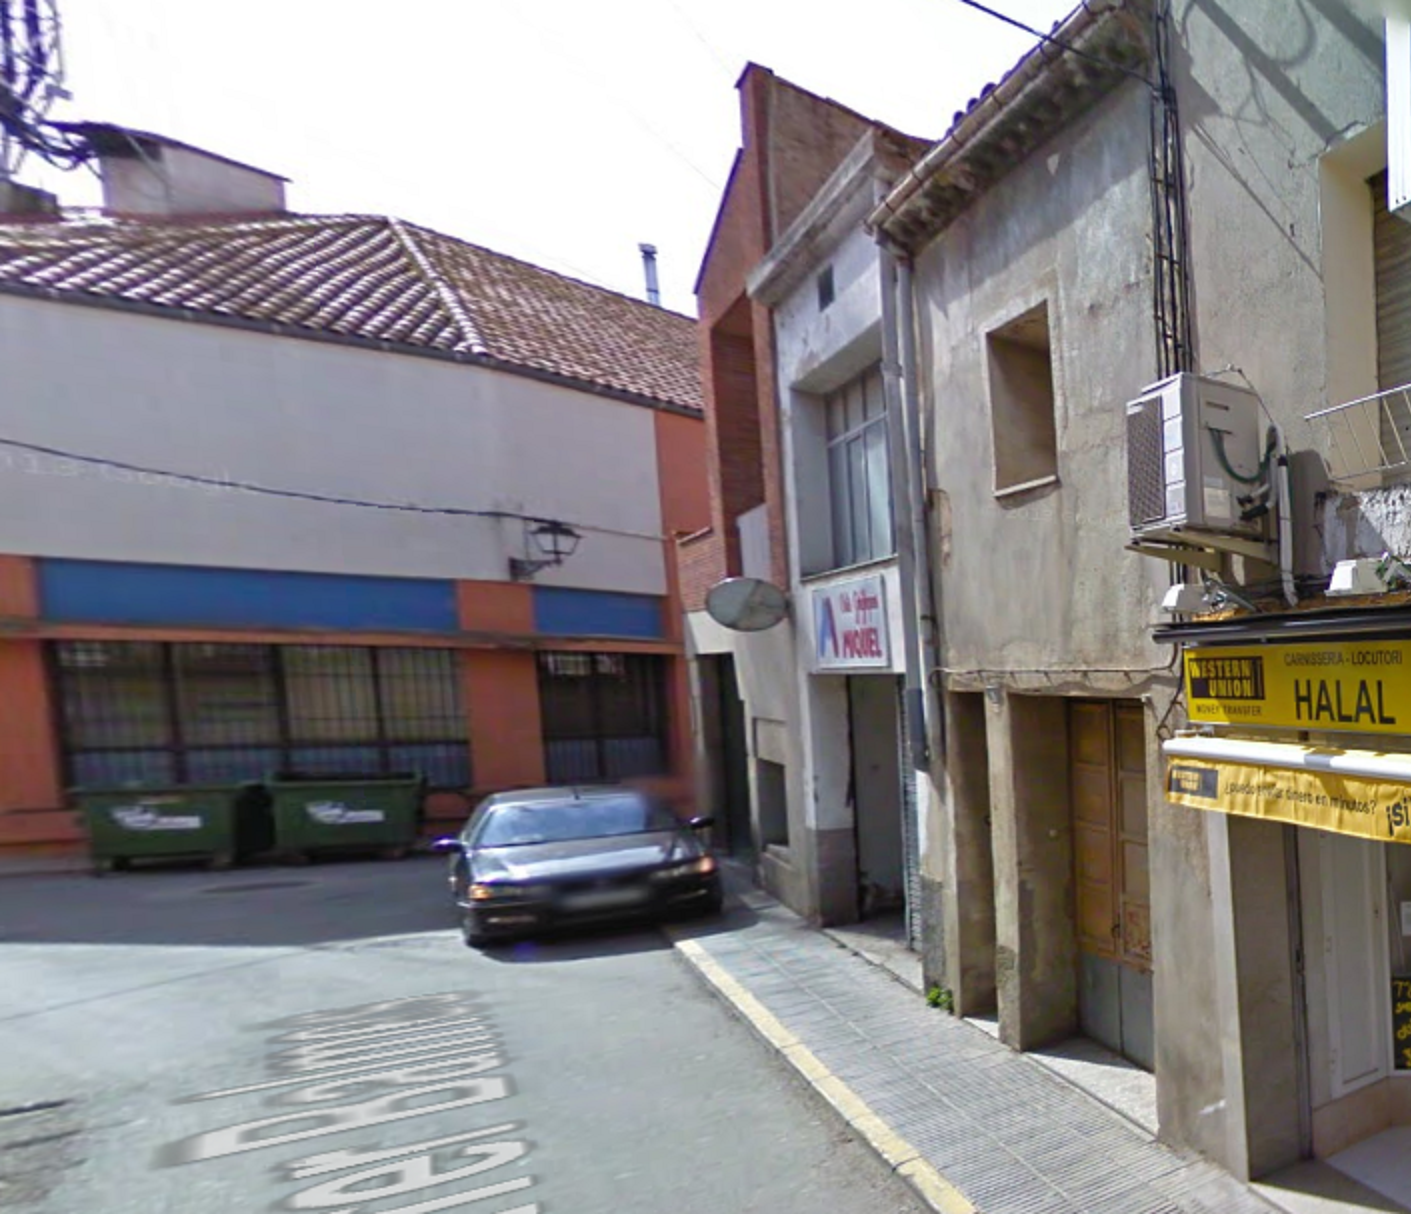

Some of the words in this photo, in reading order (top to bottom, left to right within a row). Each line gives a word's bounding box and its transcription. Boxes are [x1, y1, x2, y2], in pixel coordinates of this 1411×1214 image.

[843, 628, 882, 658] MIQUEL
[1284, 651, 1344, 666] CARNISSERIA
[1351, 650, 1403, 665] LOCUTORI
[1189, 659, 1250, 679] WESTERN
[1208, 679, 1252, 697] UNION
[1196, 703, 1219, 715] MONEY
[1223, 705, 1262, 716] TRANSFER
[1294, 679, 1396, 725] HALAL
